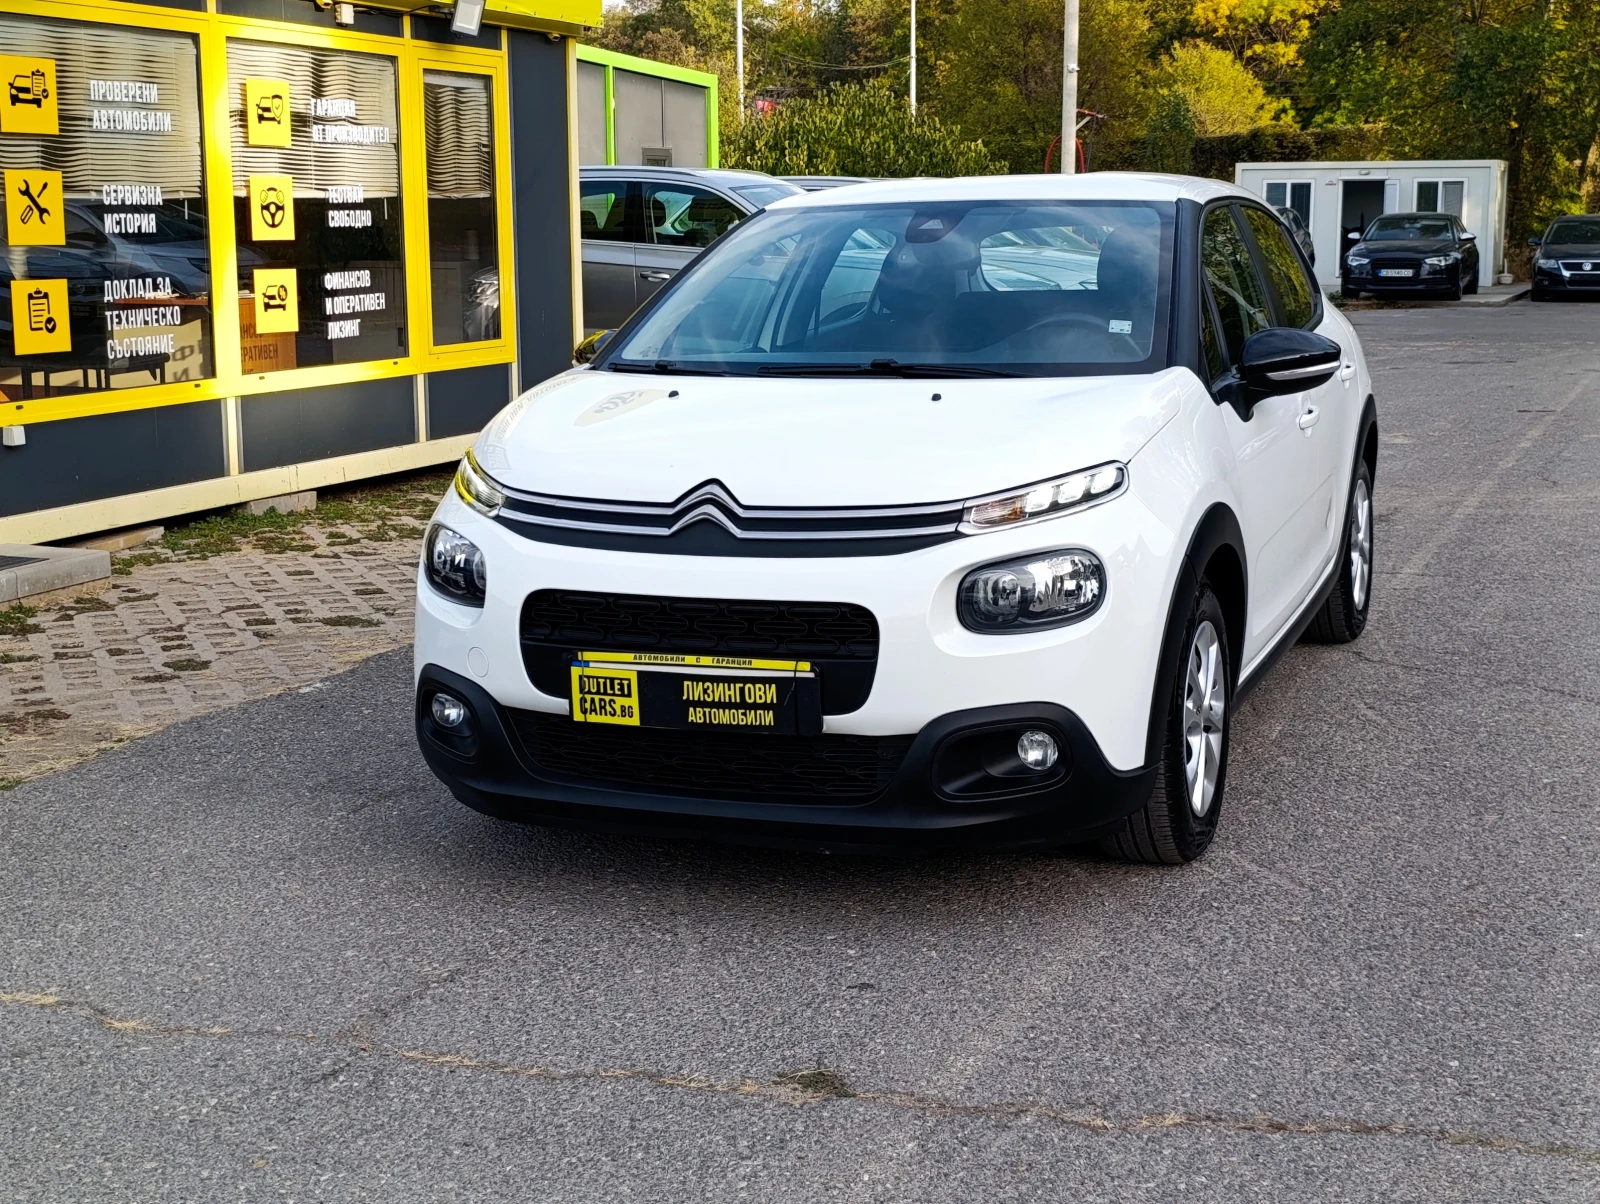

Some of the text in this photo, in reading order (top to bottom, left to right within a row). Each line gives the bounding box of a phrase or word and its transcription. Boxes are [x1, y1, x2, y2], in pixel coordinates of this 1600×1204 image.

[90, 80, 158, 103] ПРОВЕРЕНИ
[93, 110, 172, 132] АВТОМОБИЛИ
[102, 185, 163, 206] СЕРВИЗНА
[104, 213, 157, 234] ИСТОРИЯ
[328, 210, 372, 229] СВОБОДНО
[104, 277, 172, 303] ДОКЛАД ЗА
[324, 270, 371, 291] ФИНАНСОВ
[325, 292, 386, 315] И ОПЕРАТИВЕН
[105, 306, 181, 331] ТЕХНИЧЕСКО
[327, 319, 361, 340] ЛИЗИНГ
[107, 334, 175, 360] СЪСТОЯНИЕ
[633, 654, 686, 663] АВТОМОБИЛИ
[711, 657, 753, 667] ГАРАНЦИЯ
[682, 680, 777, 704] ЛИЗИНГОВИ
[580, 696, 634, 719] CARS.BG
[688, 707, 775, 726] АВТОМОБИЛИ
